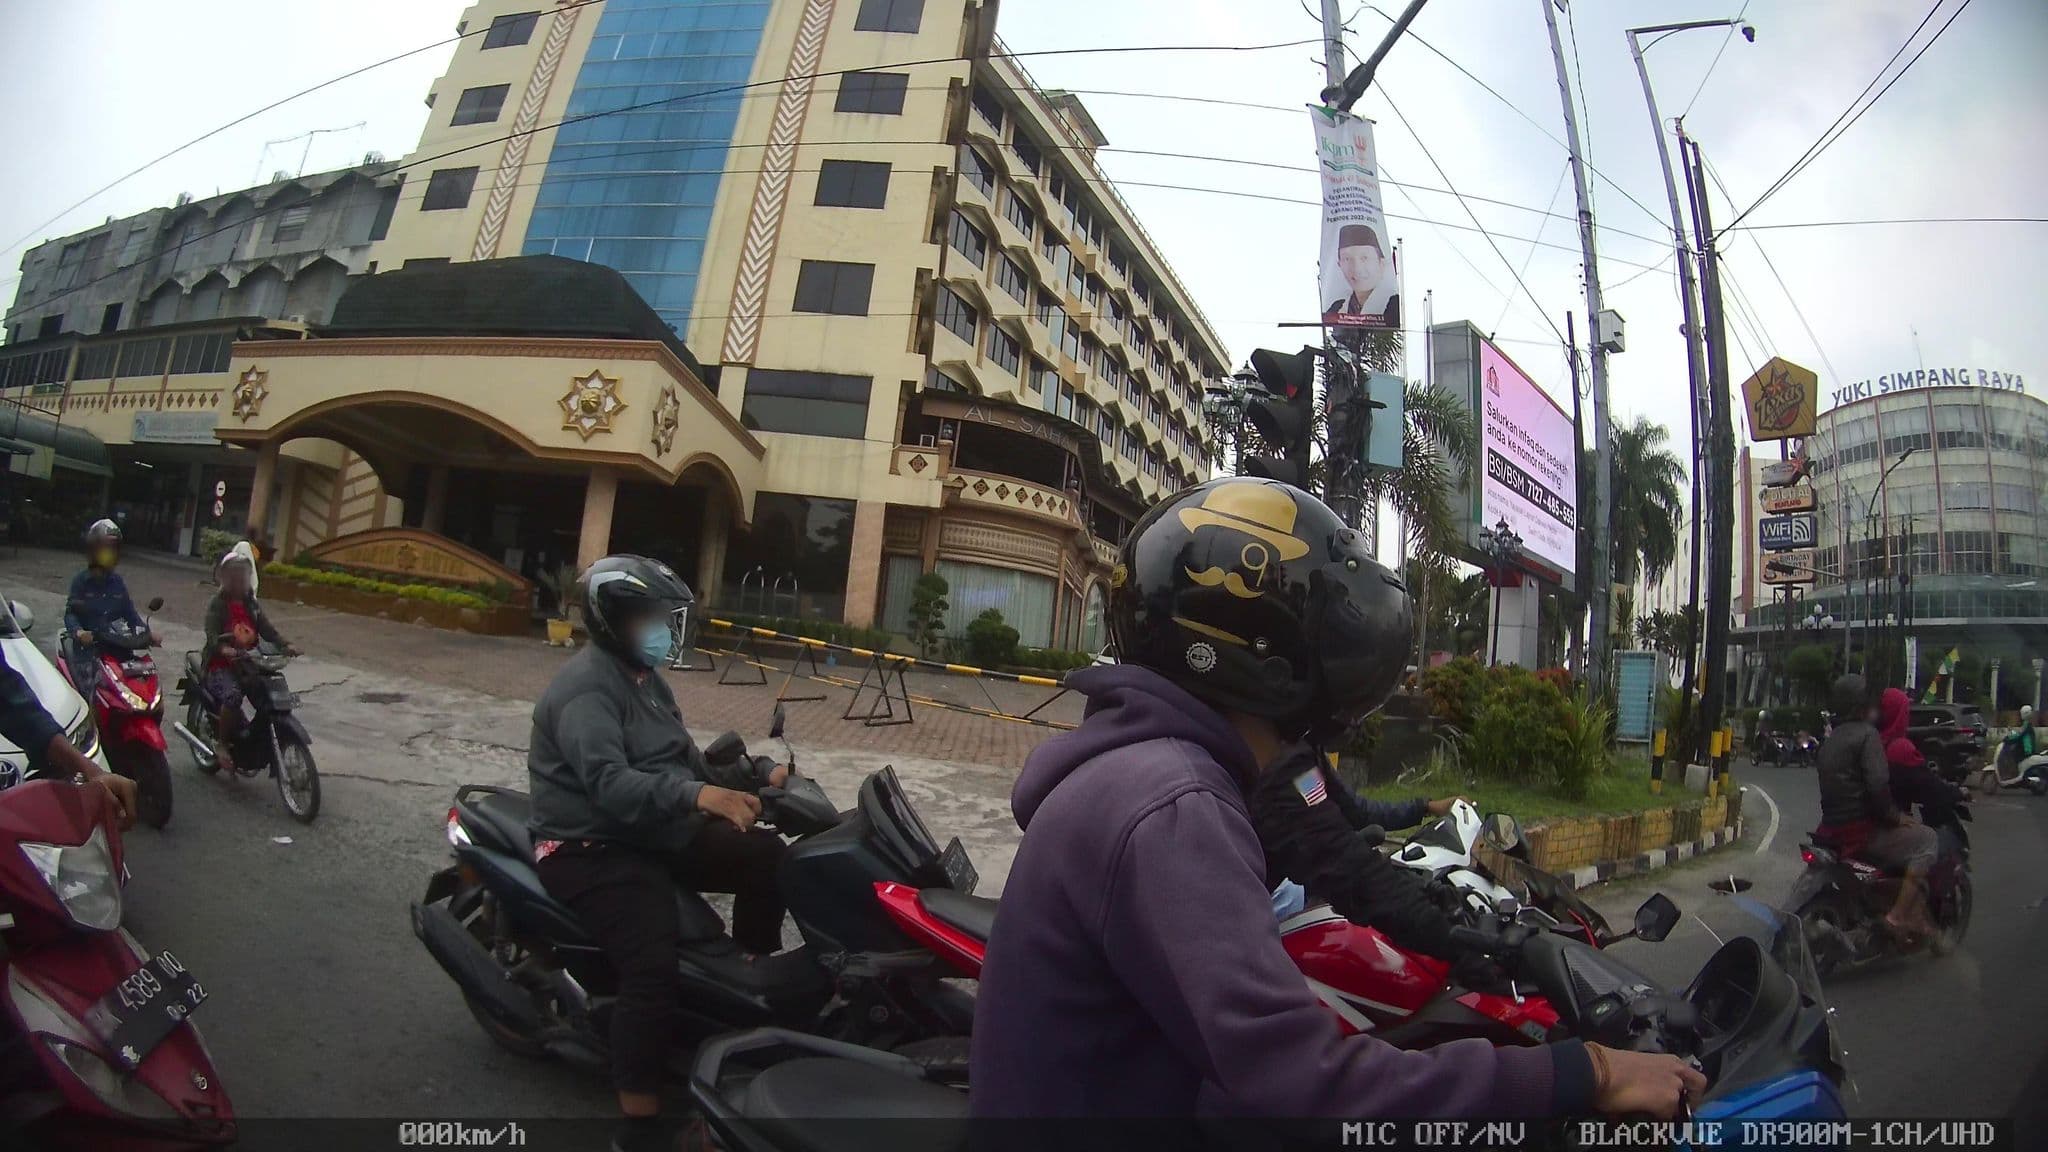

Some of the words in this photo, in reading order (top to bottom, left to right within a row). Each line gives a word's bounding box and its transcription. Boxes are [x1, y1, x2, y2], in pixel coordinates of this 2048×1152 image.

[1832, 379, 1872, 408] YUKI
[1878, 367, 1970, 394] SIMPANG
[1977, 368, 2025, 393] RAYA
[1487, 401, 1518, 437] Salurkan
[1487, 423, 1506, 446] anda
[1507, 435, 1517, 453] ke
[117, 967, 162, 1011] 4589
[187, 983, 208, 1003] 22
